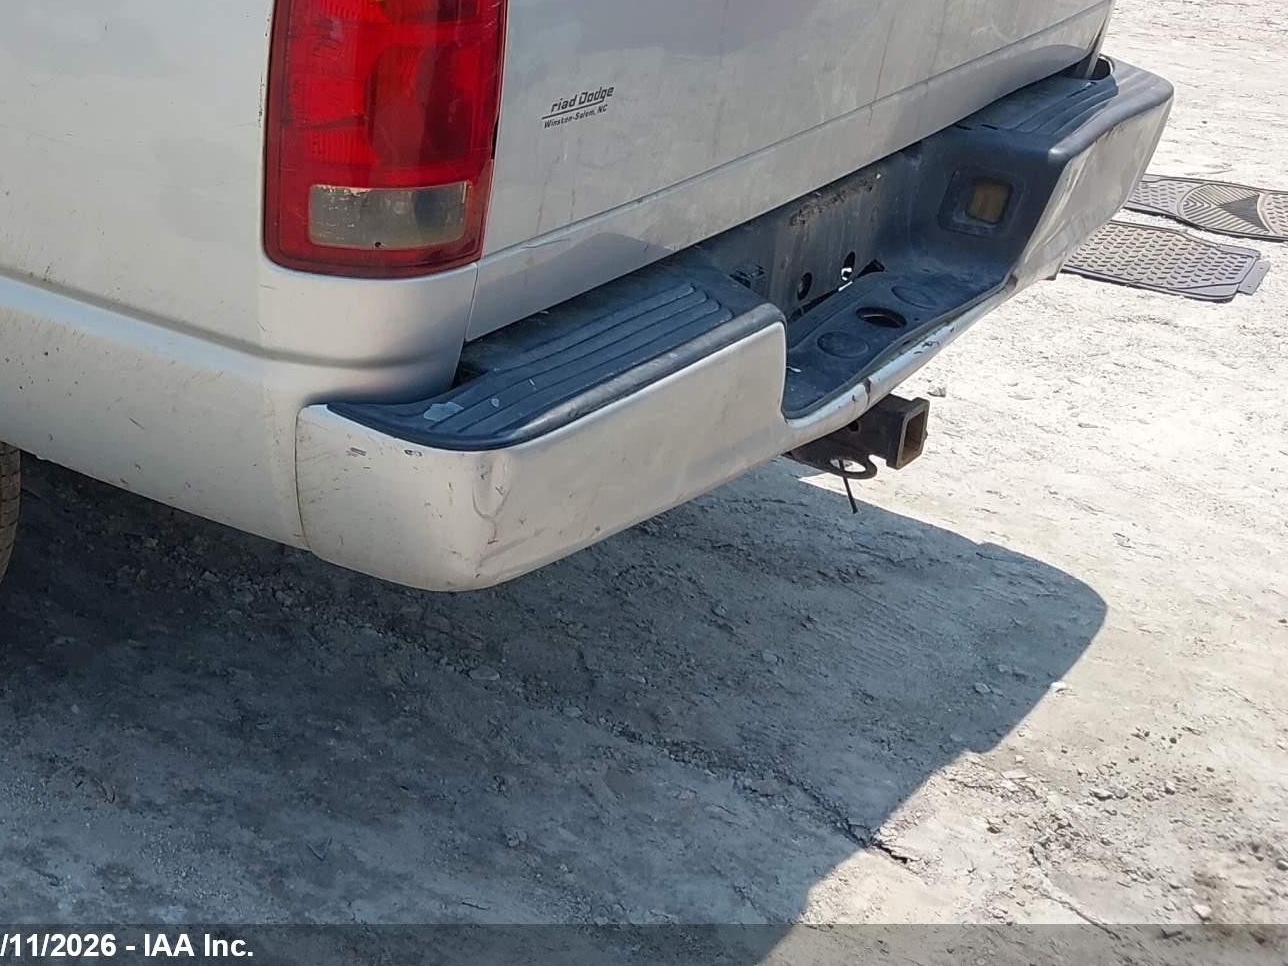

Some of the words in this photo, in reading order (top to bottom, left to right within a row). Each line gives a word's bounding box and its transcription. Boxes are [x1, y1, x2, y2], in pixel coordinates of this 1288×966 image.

[578, 86, 615, 105] Dodge
[544, 109, 596, 129] Winston-Salem,
[597, 104, 608, 115] NC
